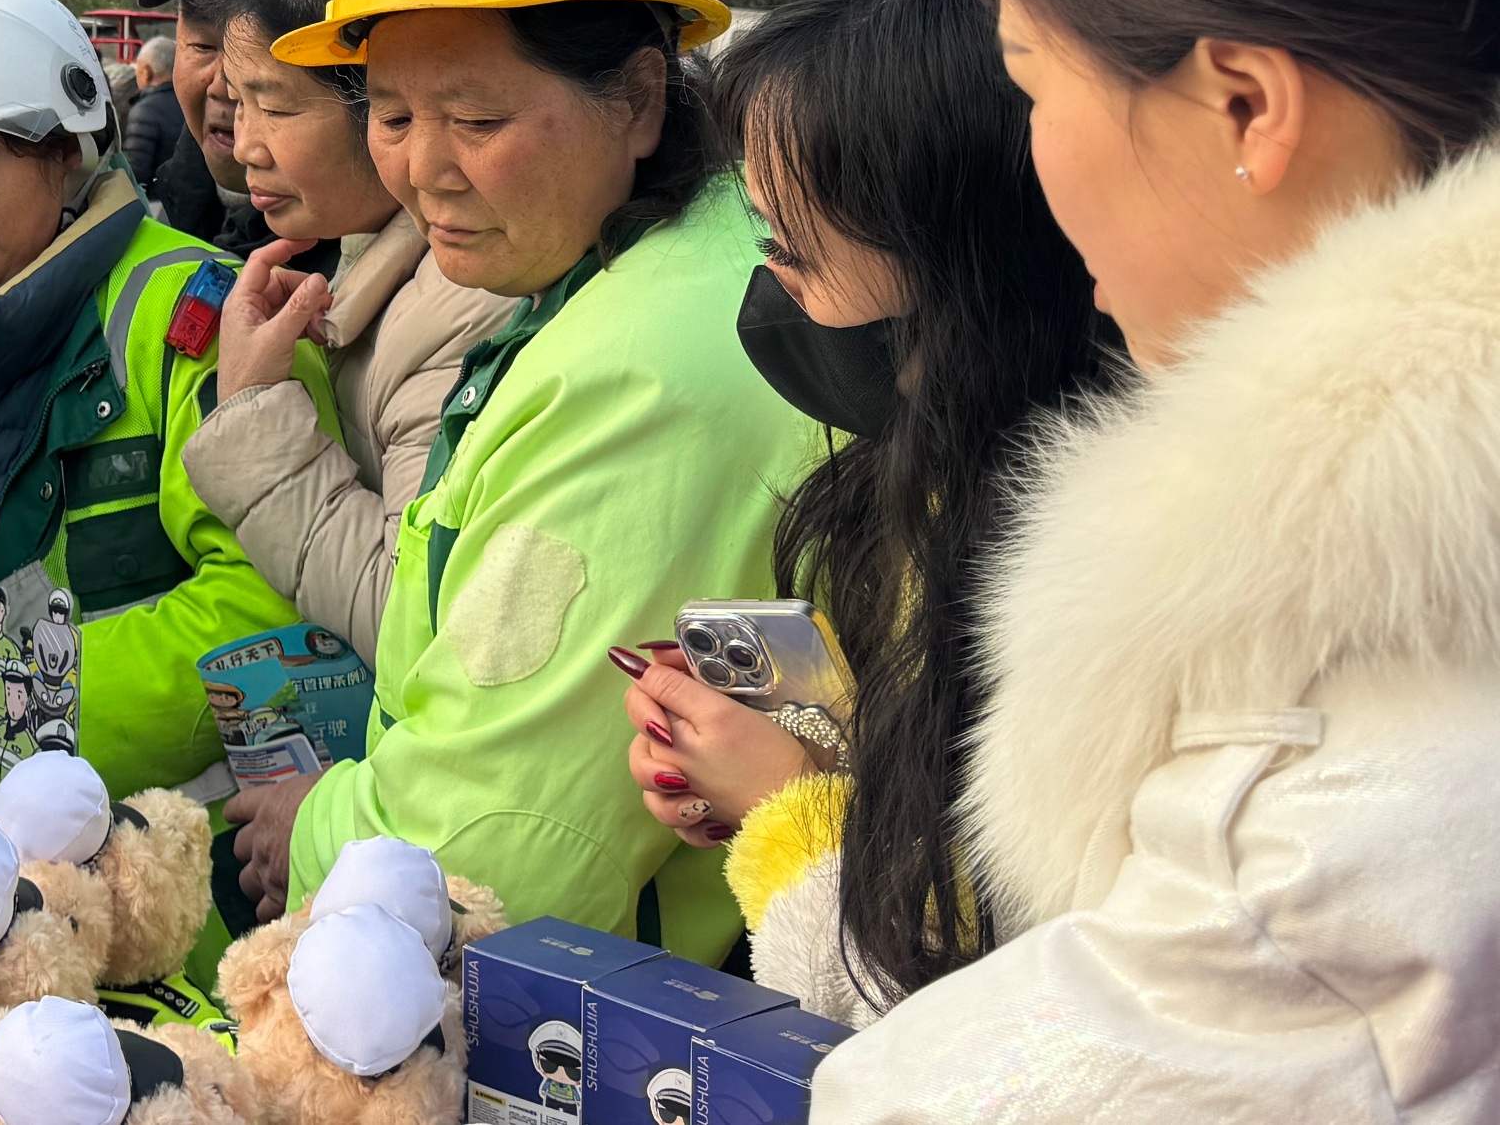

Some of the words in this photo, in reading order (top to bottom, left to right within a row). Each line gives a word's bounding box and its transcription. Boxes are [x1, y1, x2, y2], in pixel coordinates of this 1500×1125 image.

[468, 960, 479, 1047] SHUSHUJIA
[586, 1002, 598, 1091] SHUSHUJIA
[697, 1056, 709, 1125] USHUJIA
